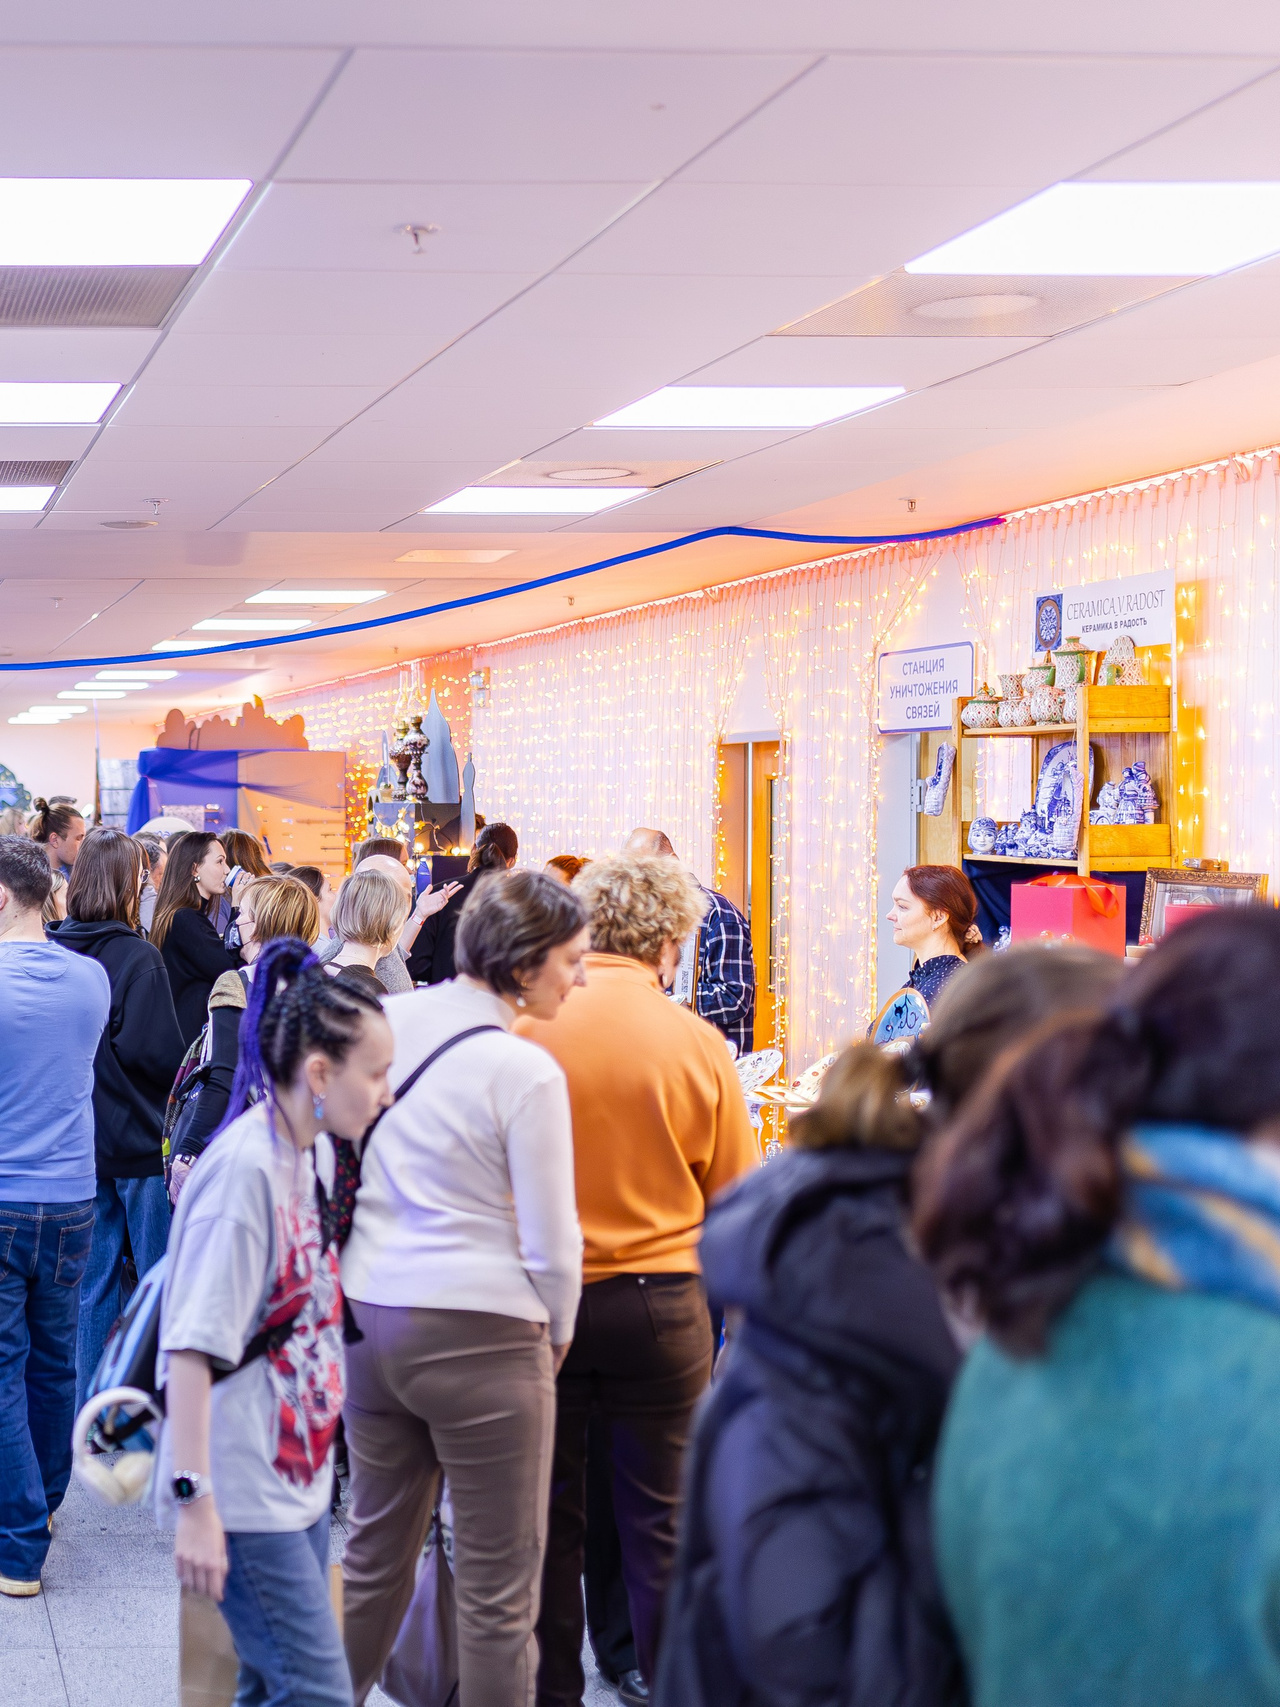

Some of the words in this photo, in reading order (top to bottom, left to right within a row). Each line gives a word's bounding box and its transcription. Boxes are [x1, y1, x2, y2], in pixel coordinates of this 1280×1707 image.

[1081, 621, 1113, 633] КЕРАМИКА
[1114, 621, 1118, 630] В
[1119, 617, 1147, 629] РАДОСТЬ
[902, 658, 945, 676] СТАНЦИЯ
[890, 679, 958, 699] УНИЧТОЖЕНИЯ
[906, 701, 940, 719] СВЯЗЕЙ
